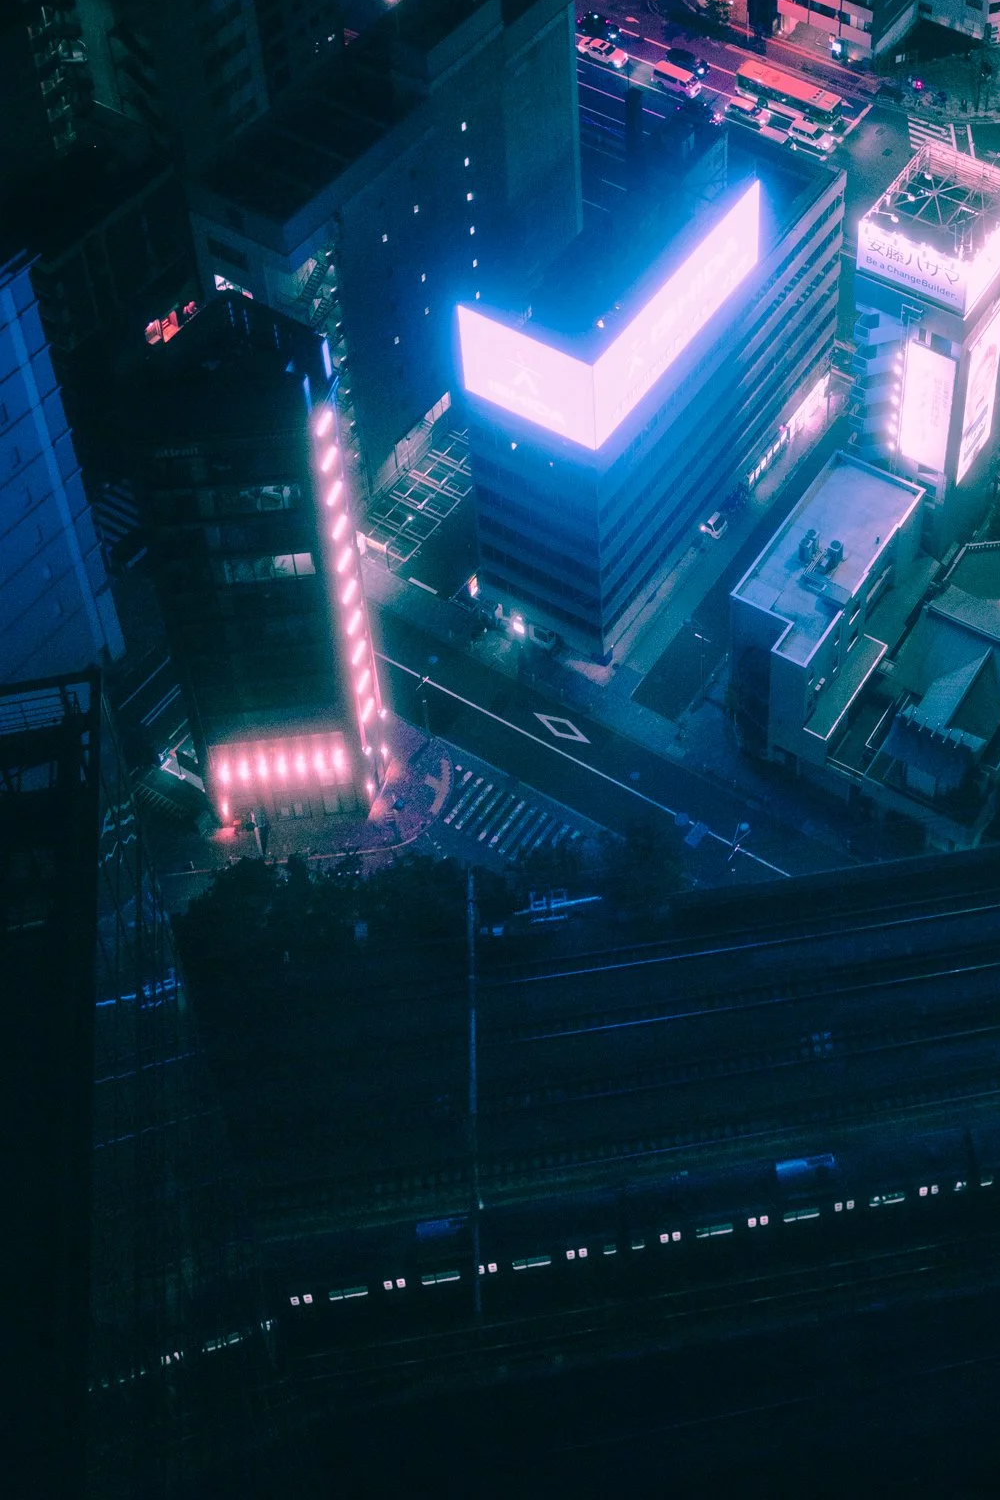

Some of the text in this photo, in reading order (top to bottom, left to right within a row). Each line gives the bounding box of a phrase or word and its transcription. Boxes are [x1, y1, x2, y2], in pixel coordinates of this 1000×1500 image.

[866, 255, 878, 266] Be
[867, 236, 960, 286] 安藤ハザマ
